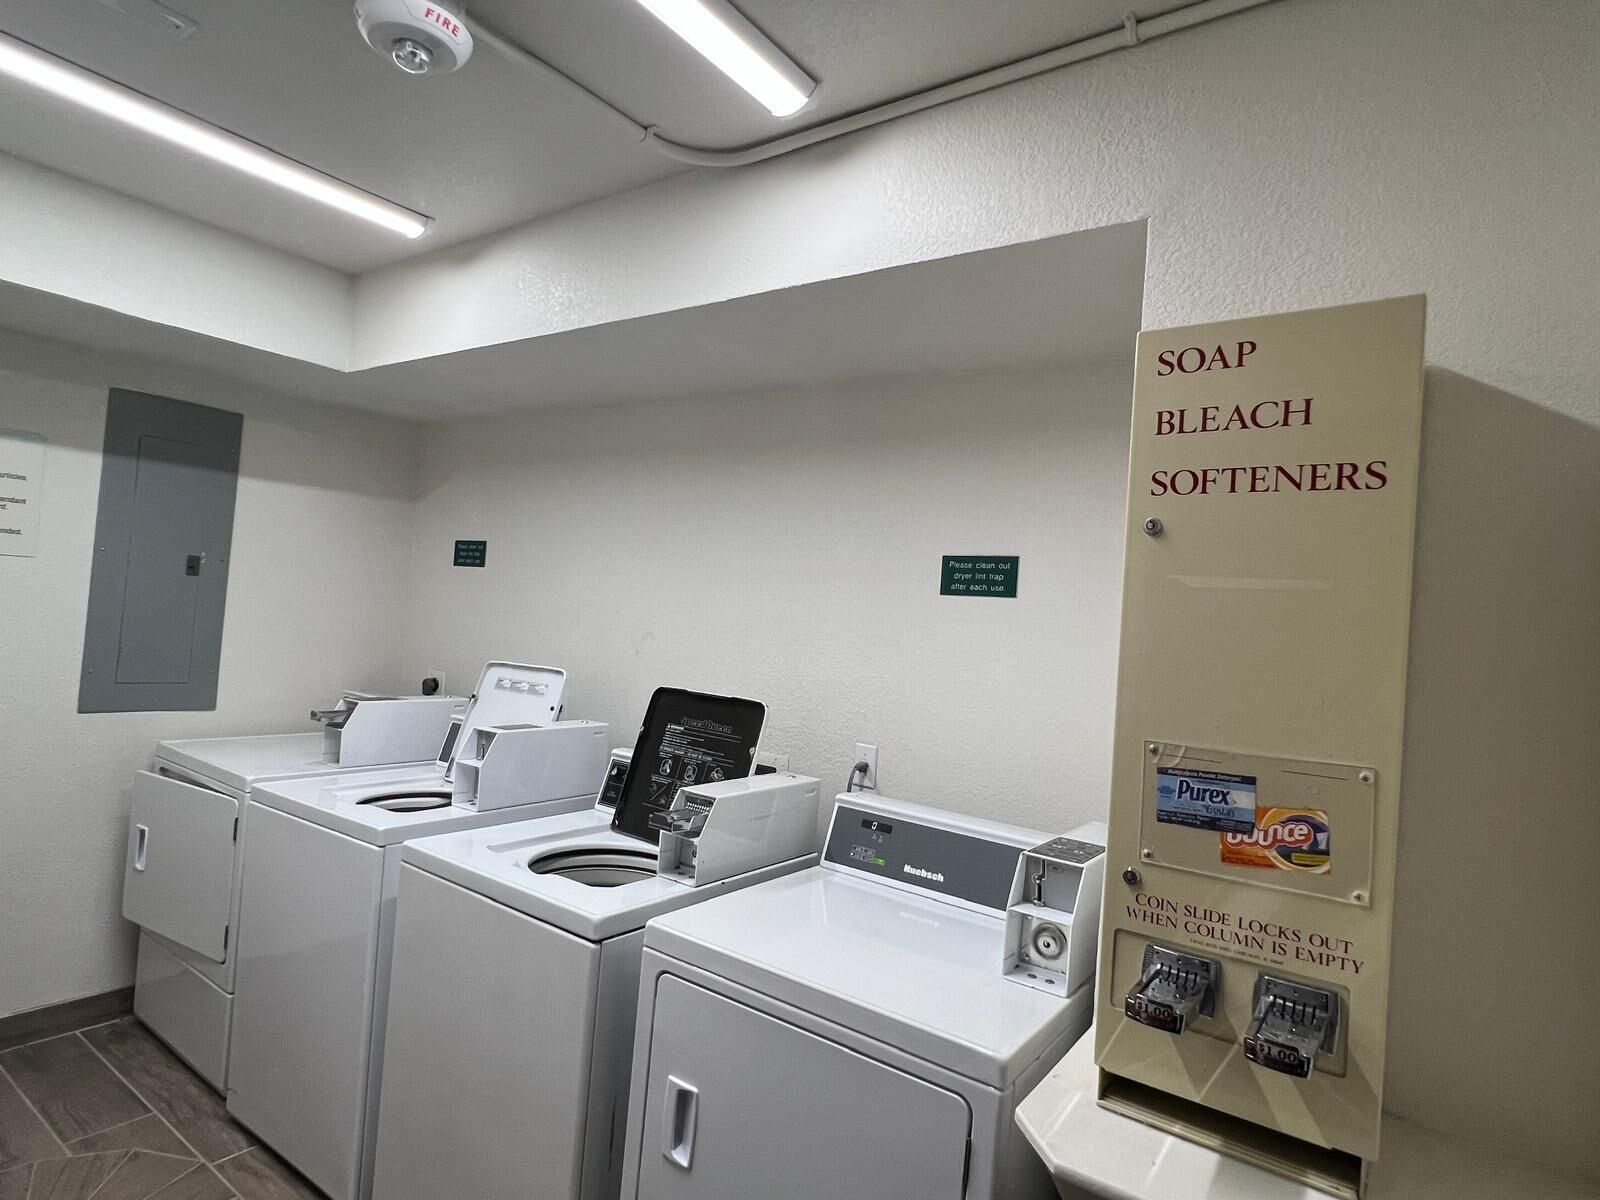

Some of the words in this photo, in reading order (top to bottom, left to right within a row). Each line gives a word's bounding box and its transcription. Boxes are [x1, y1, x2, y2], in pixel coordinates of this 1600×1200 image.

[424, 7, 460, 37] FIRE
[1157, 340, 1257, 376] SOAP
[1154, 398, 1314, 435] BLEACH
[1150, 461, 1388, 496] SOFTENERS
[949, 561, 973, 569] Please
[975, 561, 995, 569] clean
[998, 562, 1011, 570] out
[989, 573, 1004, 581] trap
[950, 583, 967, 591] after
[1176, 778, 1231, 806] Purex
[903, 864, 944, 882] Huebsch
[1135, 893, 1178, 914] COIN
[1183, 904, 1231, 926] SLIDE
[1238, 916, 1301, 942] LOCKS
[1308, 933, 1354, 954] OUT
[1126, 906, 1178, 929] WHEN
[1184, 921, 1265, 950] COLUMN
[1271, 941, 1288, 956] IS
[1295, 946, 1364, 974] EMPTY
[1136, 1001, 1171, 1018] $1.00
[1258, 1042, 1296, 1062] $1.00
